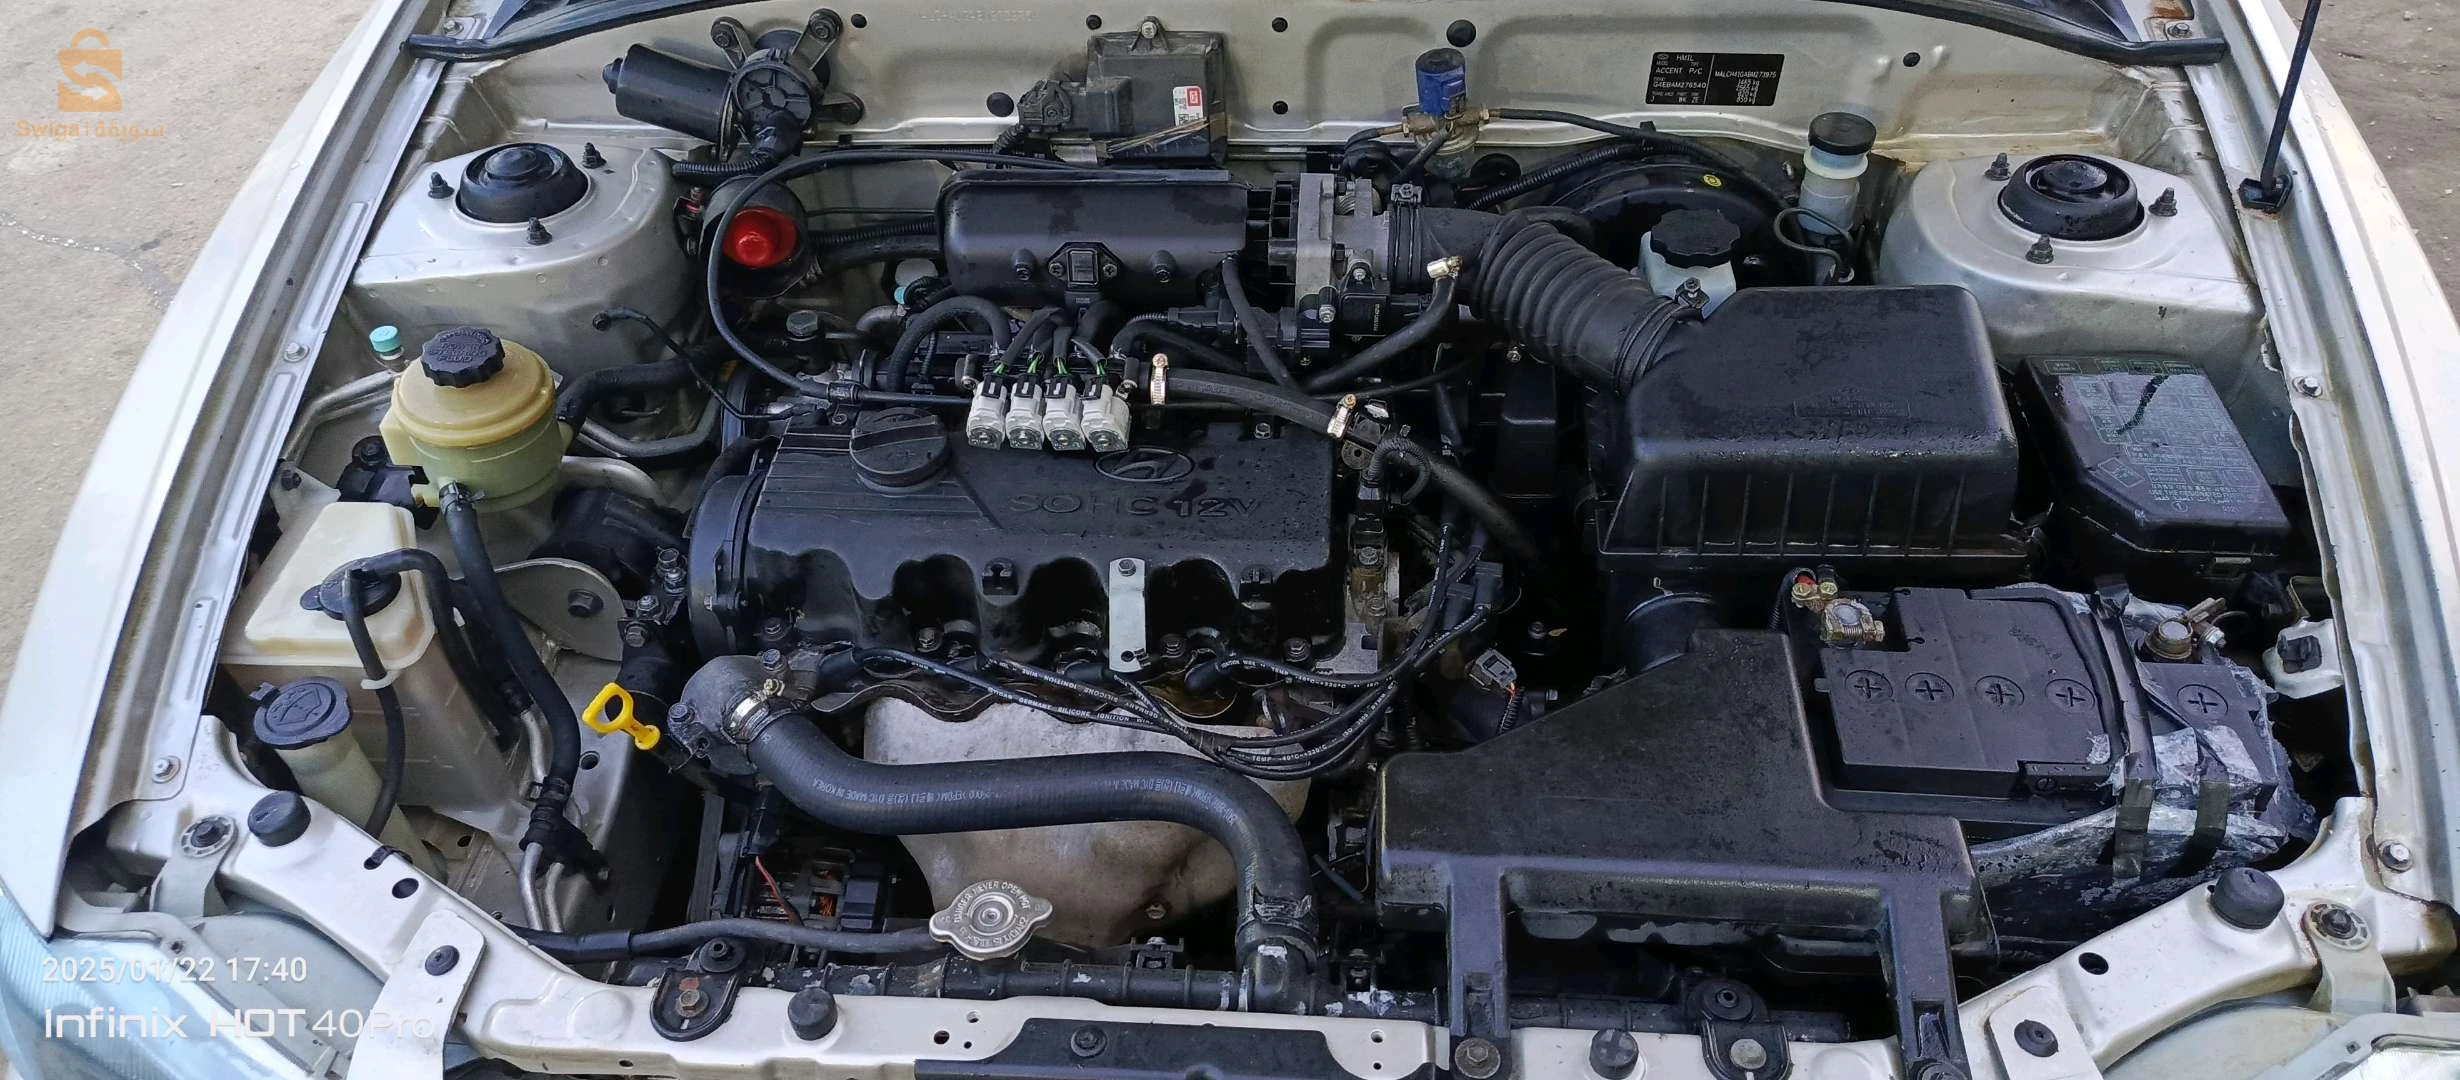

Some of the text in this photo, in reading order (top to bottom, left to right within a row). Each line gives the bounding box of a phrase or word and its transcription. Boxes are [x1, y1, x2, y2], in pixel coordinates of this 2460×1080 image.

[1655, 67, 1703, 75] ACCENT P/C
[1009, 495, 1262, 518] SOHC 12V
[1022, 669, 1038, 678] WIRE
[1043, 675, 1077, 689] IGNITION
[1084, 686, 1118, 703] SILICONE
[1058, 706, 1091, 718] SILICONE
[1097, 712, 1130, 723] IGNITION
[1252, 755, 1272, 764] TEMP
[811, 777, 838, 795] KOREA
[844, 789, 867, 802] MADE
[1001, 881, 1021, 898] OPEN
